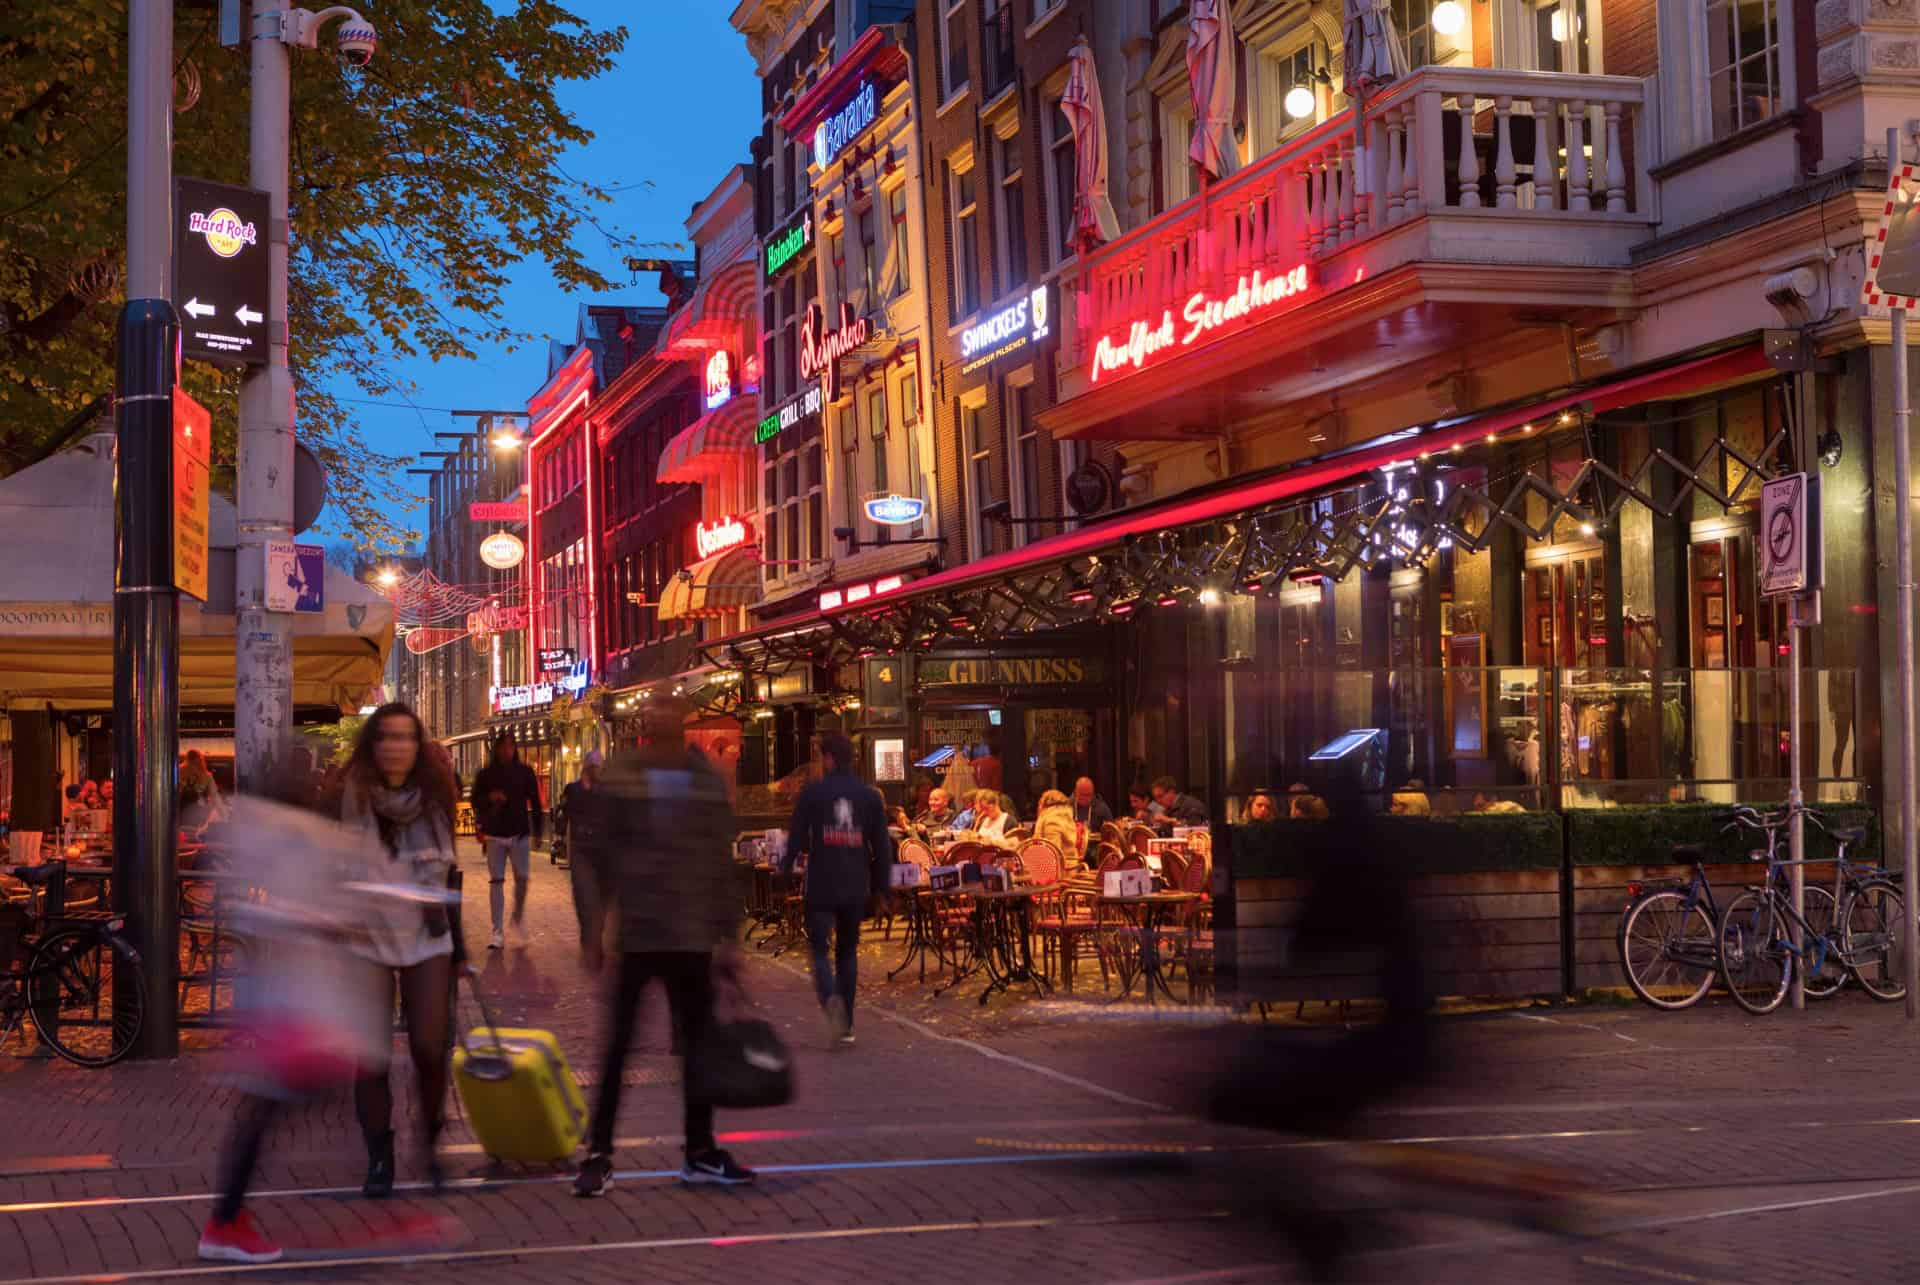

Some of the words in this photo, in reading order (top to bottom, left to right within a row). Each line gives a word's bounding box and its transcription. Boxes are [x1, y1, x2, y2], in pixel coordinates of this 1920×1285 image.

[825, 80, 875, 164] Bavaria
[190, 212, 225, 233] Hard
[227, 218, 257, 245] Rock
[767, 226, 804, 276] Heineken
[1181, 265, 1309, 345] Steakhouse
[759, 414, 780, 442] GREEN
[780, 402, 799, 429] GRILL
[804, 387, 821, 415] BBQ
[1772, 485, 1792, 498] ZONE
[879, 665, 893, 683] 4
